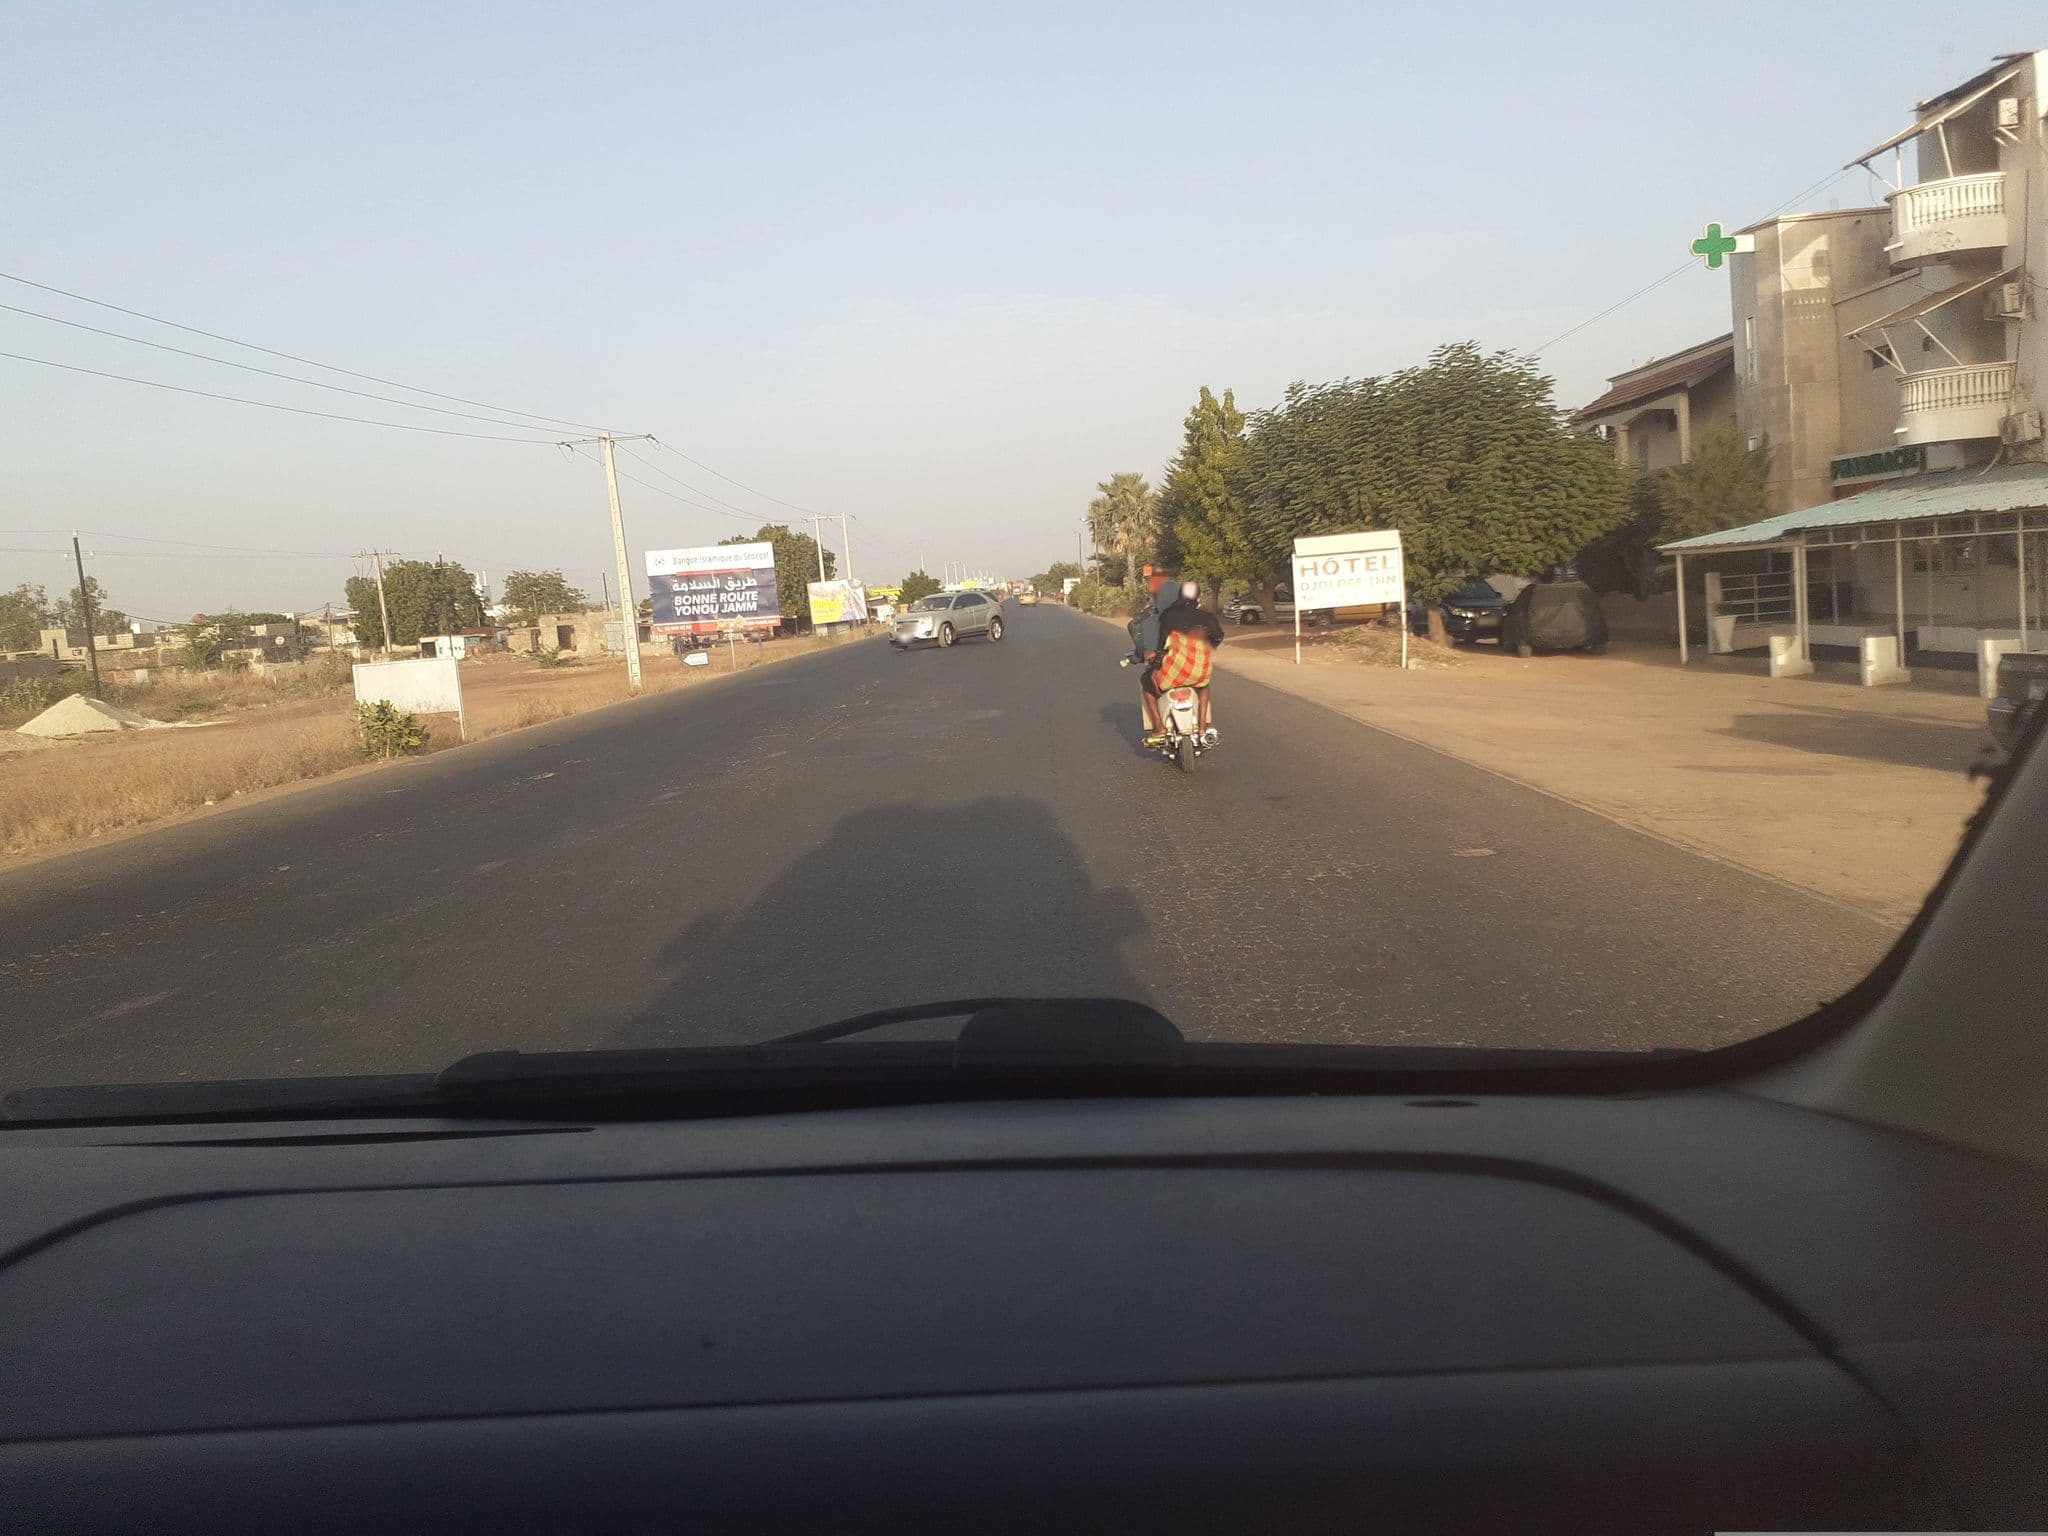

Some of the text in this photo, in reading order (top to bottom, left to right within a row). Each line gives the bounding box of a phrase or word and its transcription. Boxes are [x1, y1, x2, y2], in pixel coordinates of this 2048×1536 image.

[1300, 555, 1395, 577] HÔTEL
[672, 576, 758, 592] طريق السلامة
[674, 591, 758, 606] BONNE ROUTE
[675, 602, 758, 616] YONOU JAMM
